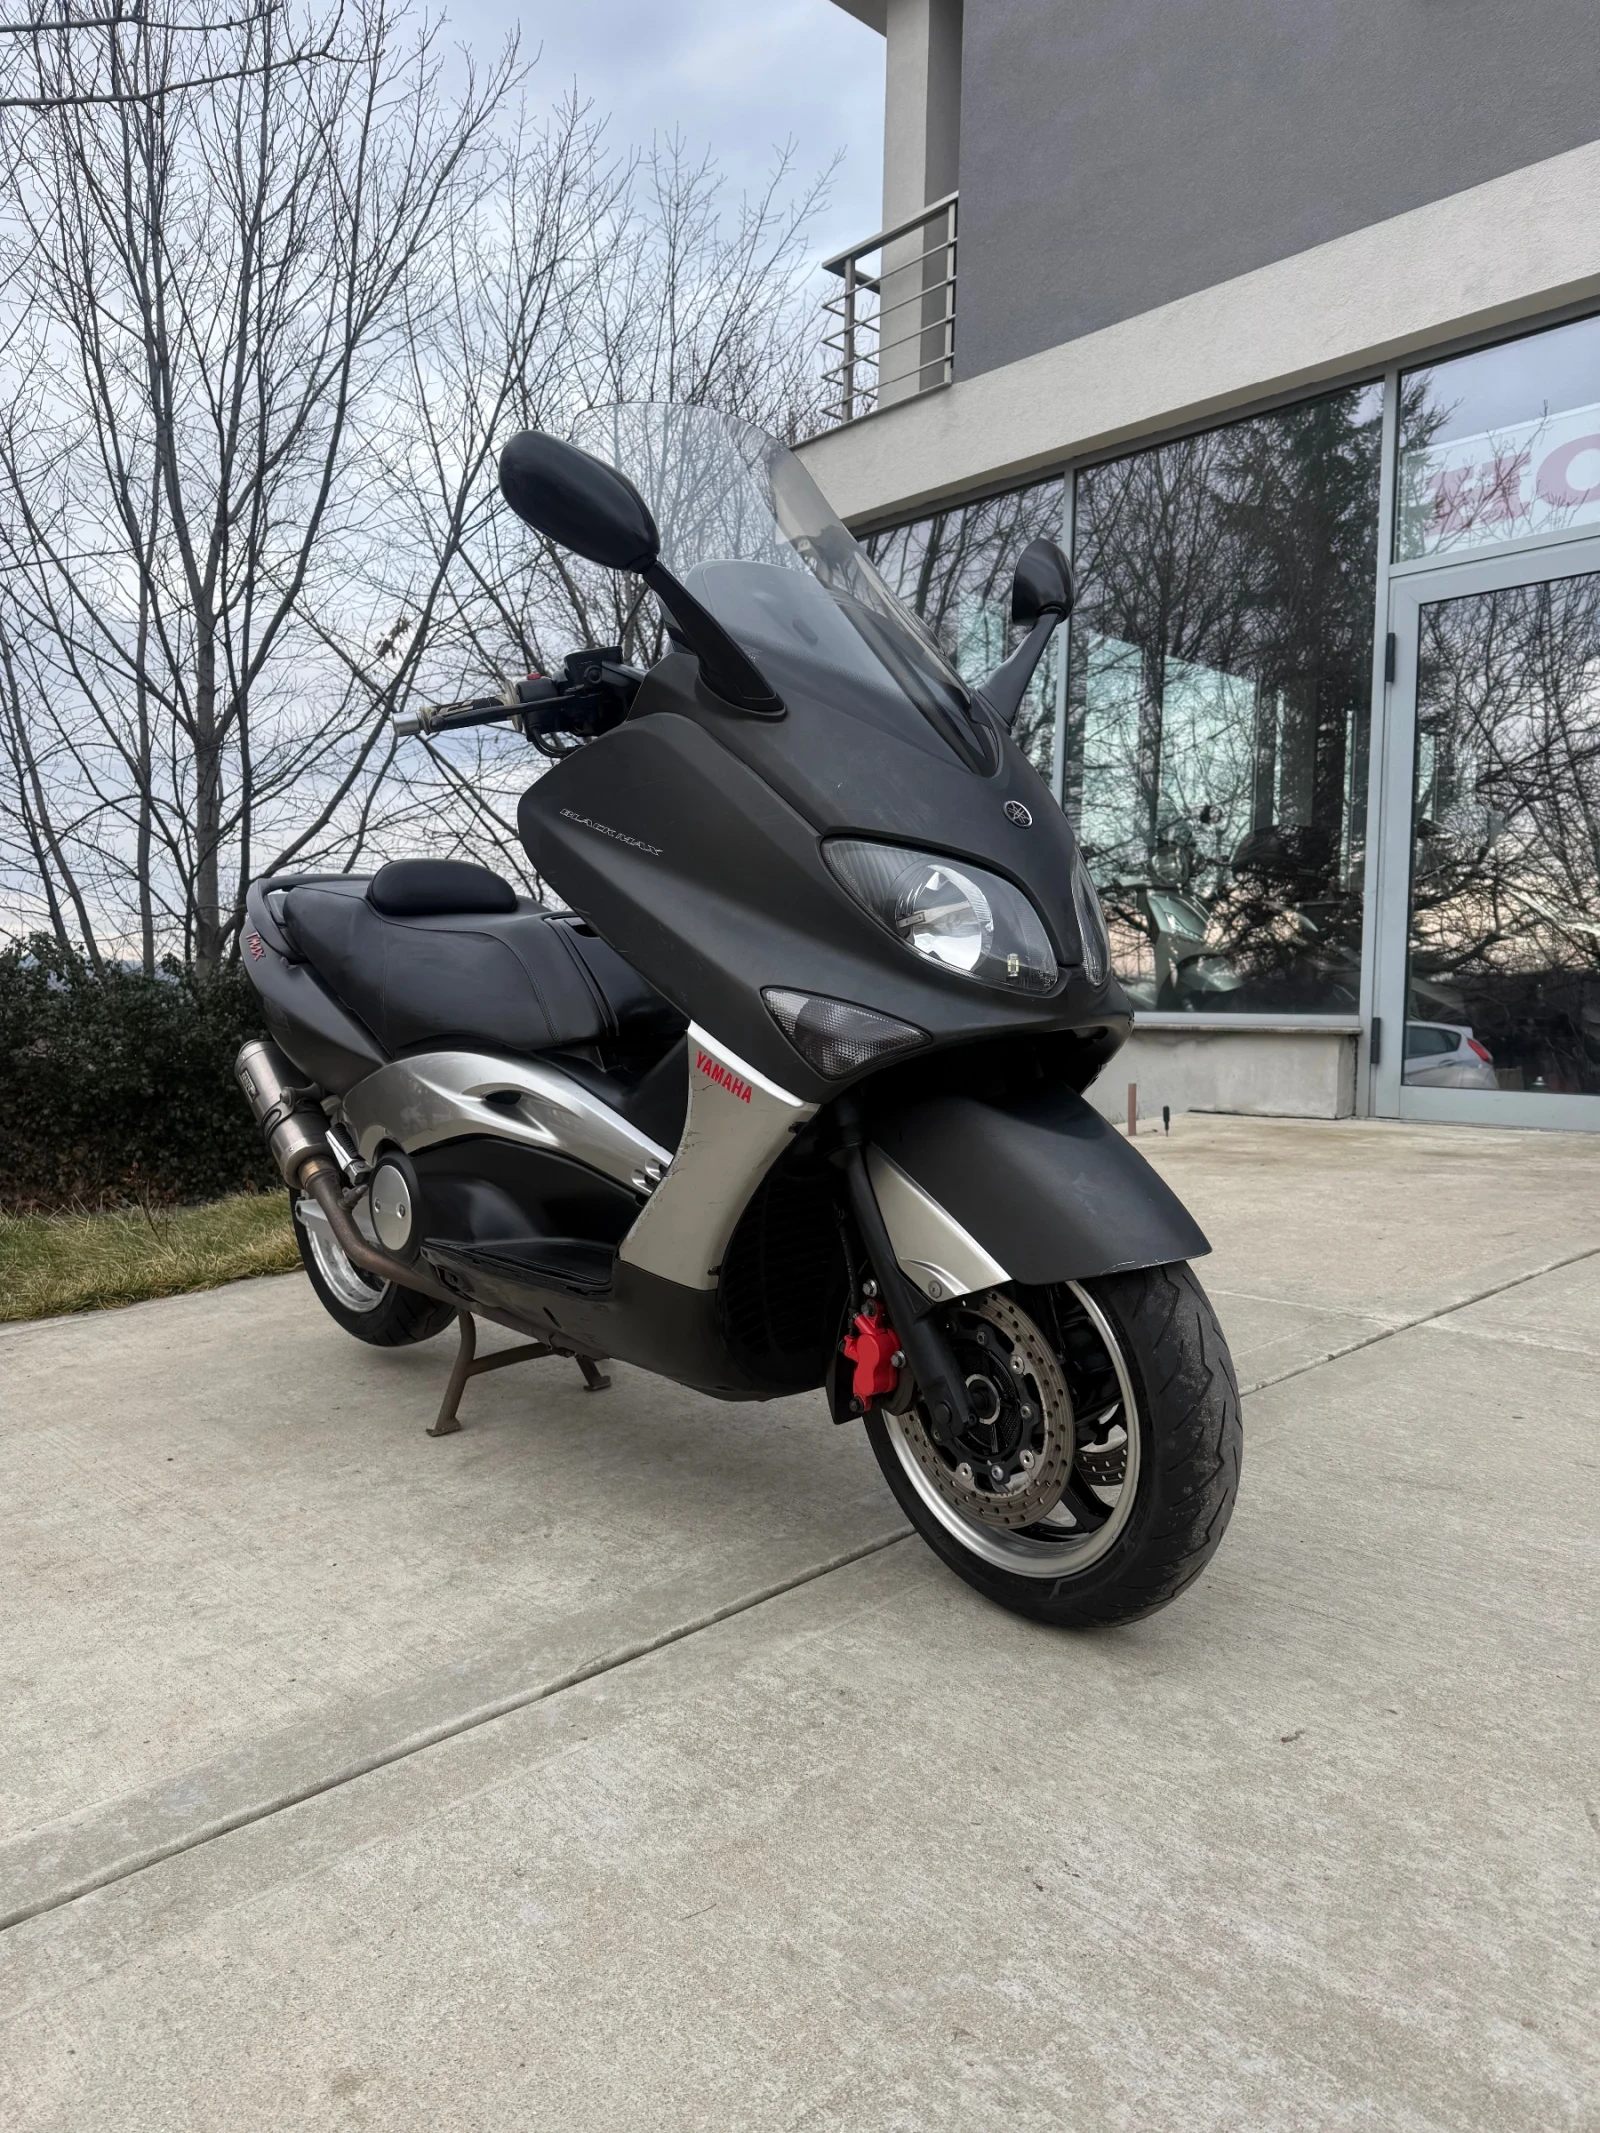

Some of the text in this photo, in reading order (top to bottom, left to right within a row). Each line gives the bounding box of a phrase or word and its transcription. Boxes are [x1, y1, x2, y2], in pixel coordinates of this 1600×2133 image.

[560, 808, 663, 856] BLACK MAX
[696, 1050, 752, 1104] YAMAHA
